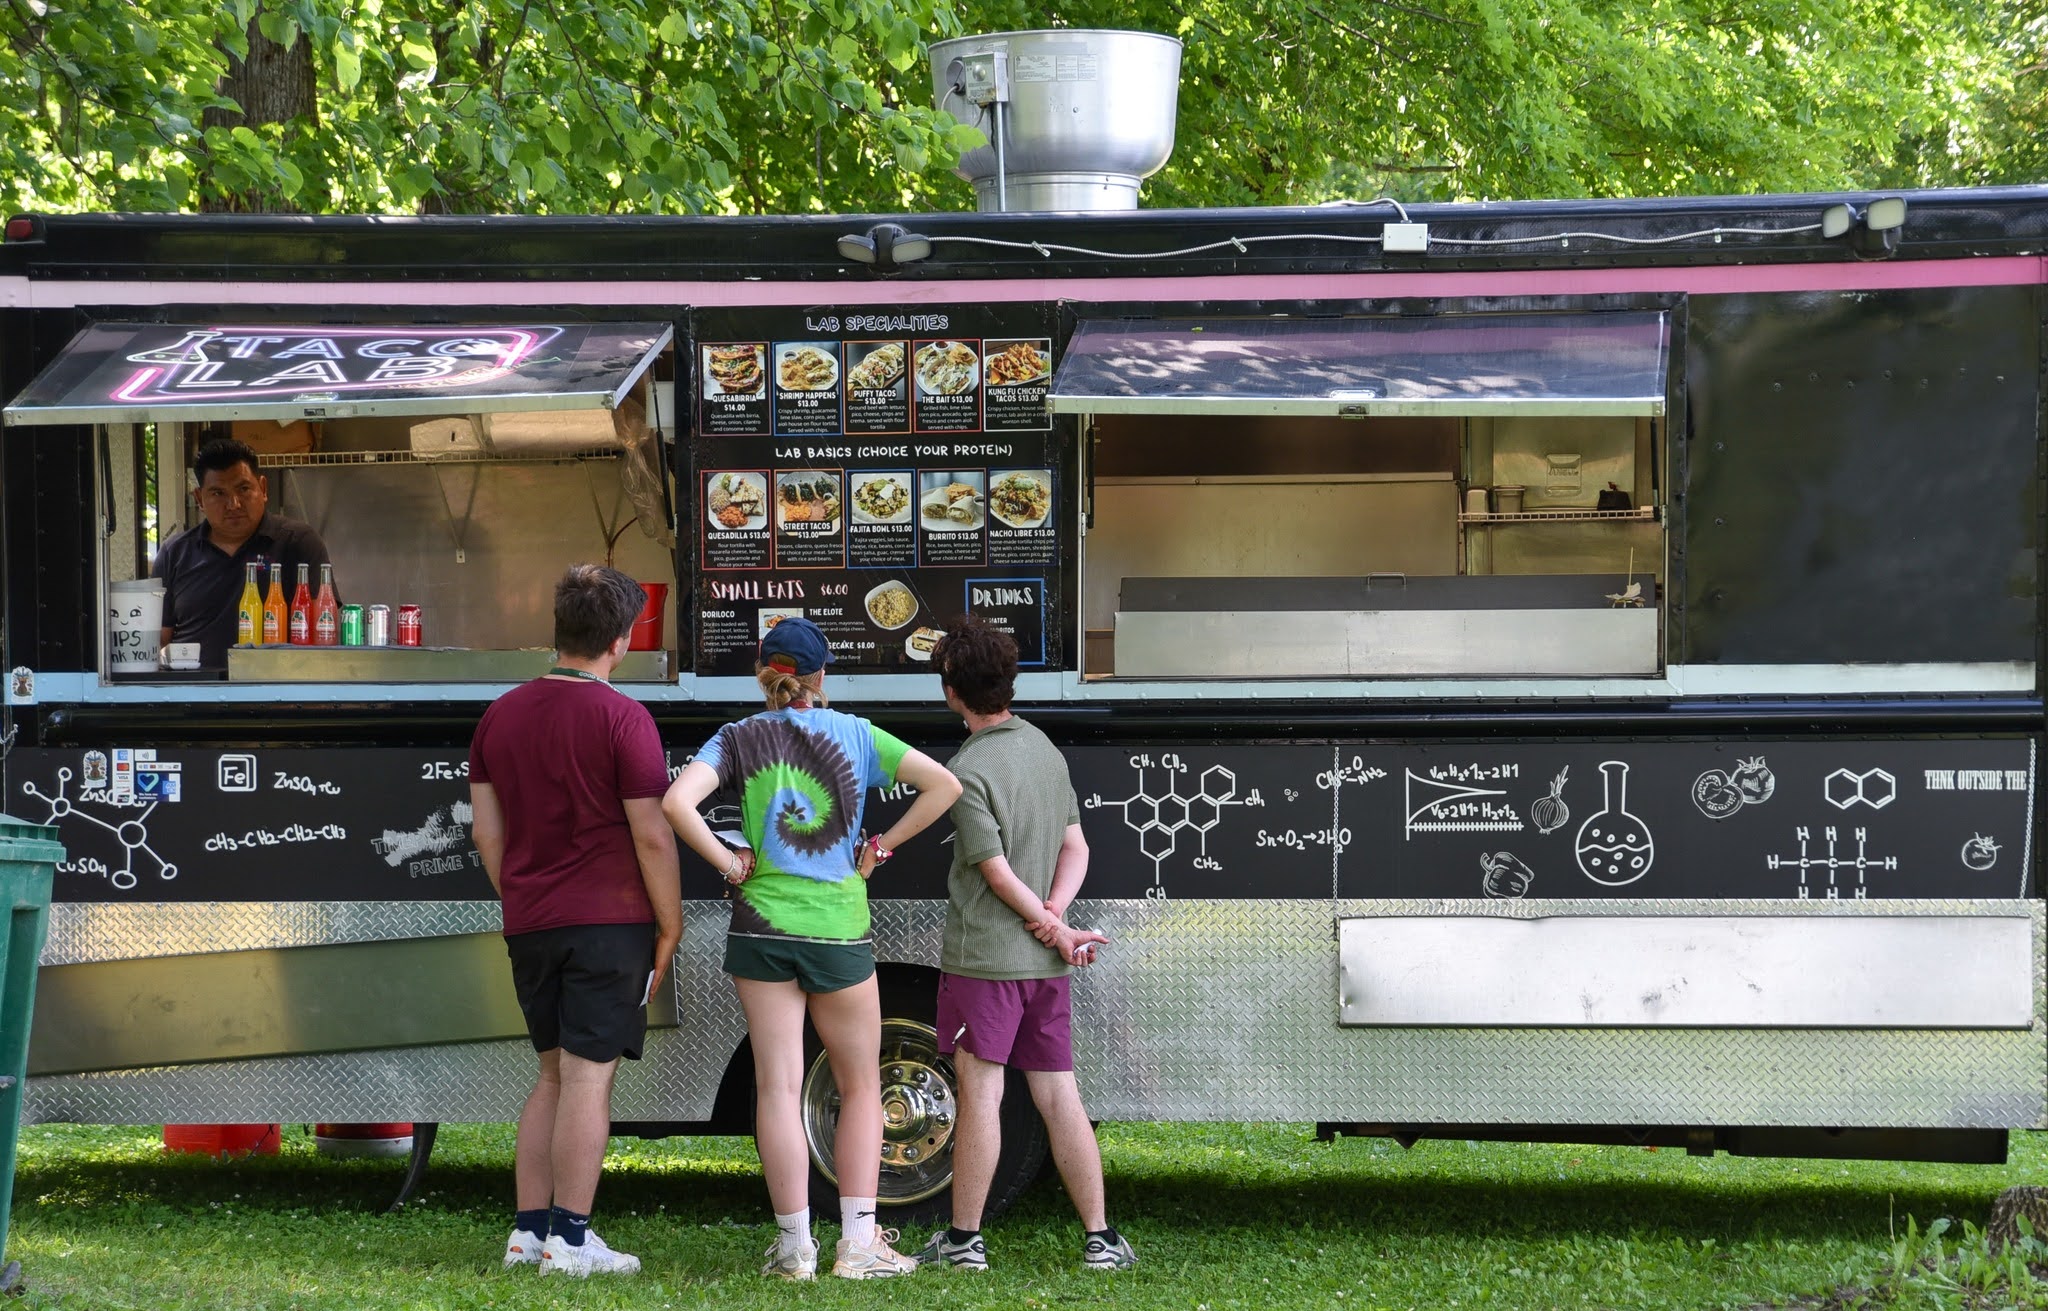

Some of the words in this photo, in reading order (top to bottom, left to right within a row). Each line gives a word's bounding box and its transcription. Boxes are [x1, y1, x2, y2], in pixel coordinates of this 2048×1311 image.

[806, 316, 840, 332] LAB
[845, 314, 949, 332] SPECIALITIES
[176, 356, 458, 387] LAB
[780, 392, 804, 400] SHRIMP
[805, 391, 836, 399] HAPPENS
[854, 390, 874, 398] PUFFY
[875, 389, 896, 397] TACOS
[1017, 387, 1046, 395] CHICKEN
[712, 394, 757, 403] QUESABIRRIA
[865, 397, 886, 405] $13.00
[1018, 394, 1039, 402] $13.00
[797, 400, 819, 408] $13.00
[775, 448, 801, 458] LAB
[808, 447, 851, 458] BASICS
[857, 446, 908, 458] (CHOICE
[915, 445, 949, 457] YOUR
[954, 444, 1013, 457] PROTEIN)
[784, 522, 809, 530] STREET
[810, 522, 831, 530] TACOS
[850, 525, 870, 533] FAJITA
[872, 525, 890, 533] BOWL
[708, 532, 748, 540] QUESADILLA
[749, 531, 770, 539] $13.00
[798, 531, 819, 539] $13.00
[957, 532, 978, 540] $13.00
[1014, 529, 1033, 537] LIBRE
[1034, 529, 1055, 537] $13.00
[711, 580, 763, 601] SMALL
[767, 579, 805, 600] EATS
[820, 582, 848, 596] $6.00
[972, 587, 1033, 608] DRINKS
[702, 610, 735, 618] DORILOCO
[809, 608, 822, 616] THE
[823, 608, 843, 616] ELOTE
[113, 630, 141, 647] IPS
[857, 642, 875, 650] $8.00
[578, 671, 596, 680] GOOD
[223, 766, 246, 785] Fe
[1957, 769, 2003, 791] OUTSIDE
[2004, 770, 2027, 790] THE
[1796, 826, 1810, 841] H
[1825, 826, 1838, 842] H
[1856, 826, 1866, 842] H
[409, 854, 464, 879] PRIME
[1767, 854, 1780, 870] H
[1885, 856, 1897, 870] H
[1798, 886, 1809, 900] H
[1826, 887, 1838, 900] H
[1854, 886, 1866, 899] H
